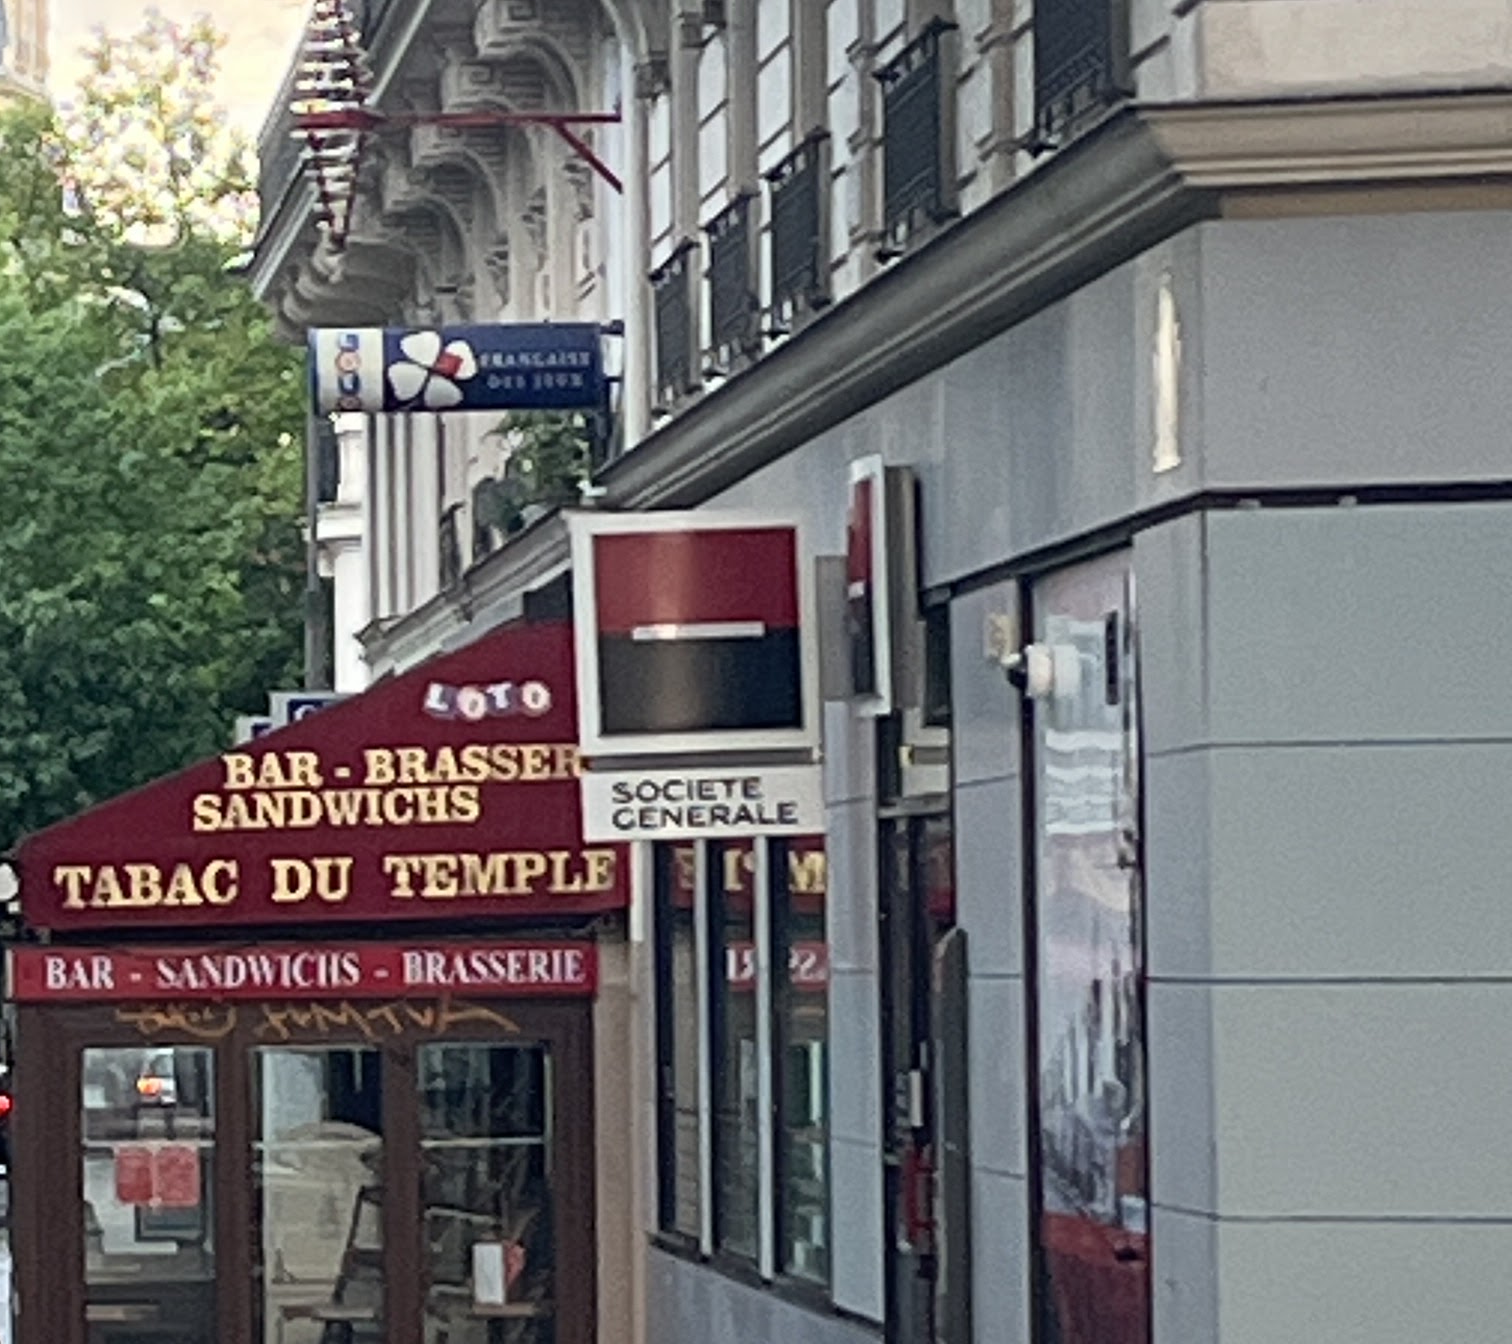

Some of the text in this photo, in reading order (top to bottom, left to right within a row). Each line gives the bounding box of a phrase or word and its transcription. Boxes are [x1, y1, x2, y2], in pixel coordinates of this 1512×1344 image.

[424, 681, 551, 719] LOTO
[222, 751, 324, 790] BAR
[612, 776, 763, 804] SOCIETE
[193, 785, 481, 832] SANDWICHS
[612, 803, 799, 831] GENERALE
[54, 859, 239, 909] TABAC
[270, 856, 354, 902] DU
[383, 849, 617, 898] TEMPLE
[46, 955, 115, 990] BAR
[155, 950, 361, 990] SANDWICHS
[402, 948, 586, 985] BRASSERIE
